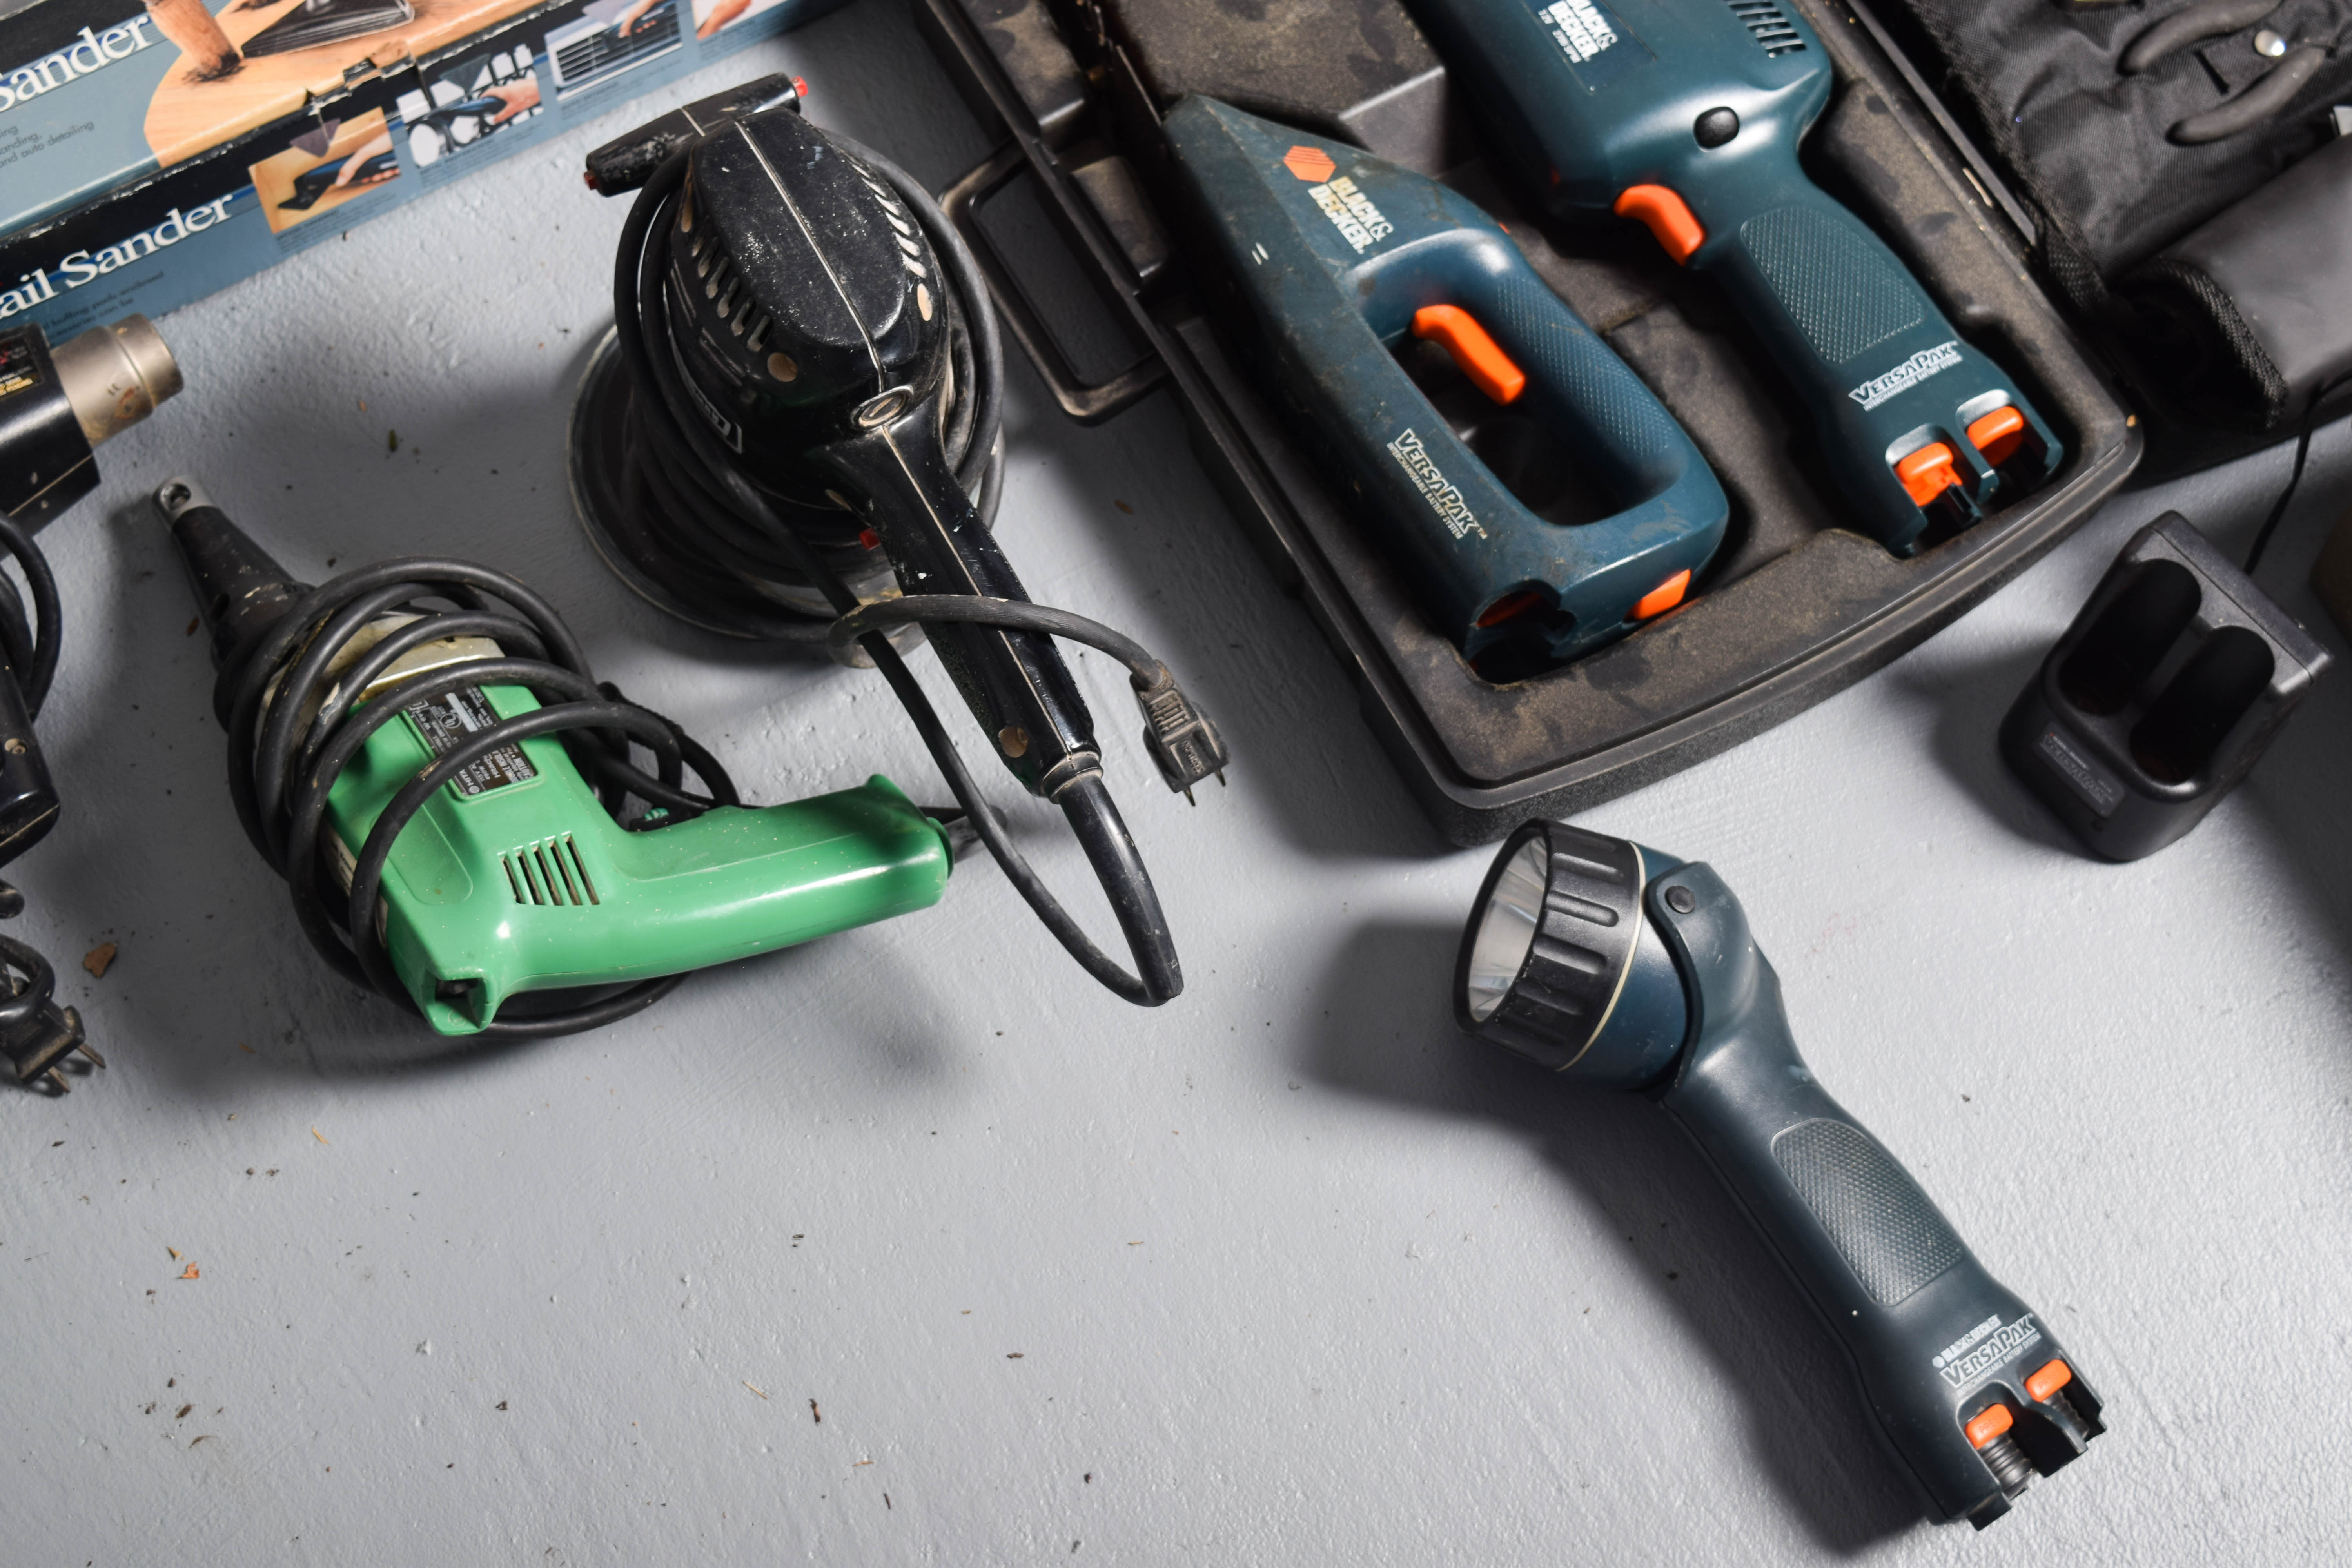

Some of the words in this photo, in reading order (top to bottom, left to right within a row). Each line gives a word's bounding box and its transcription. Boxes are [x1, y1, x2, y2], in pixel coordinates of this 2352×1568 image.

[0, 125, 19, 138] ing
[0, 133, 42, 154] anding,
[21, 143, 45, 158] auto
[47, 121, 95, 146] detailing
[0, 268, 59, 319] ail
[60, 194, 233, 288] Sander
[1386, 441, 1429, 494] INTERCHANGEABLE
[1425, 492, 1444, 518] BATTERY
[1443, 516, 1464, 540] SYSTEM
[459, 769, 474, 786] HITA
[2002, 1345, 2024, 1366] BATTERY
[2023, 1332, 2042, 1349] SYSTEM
